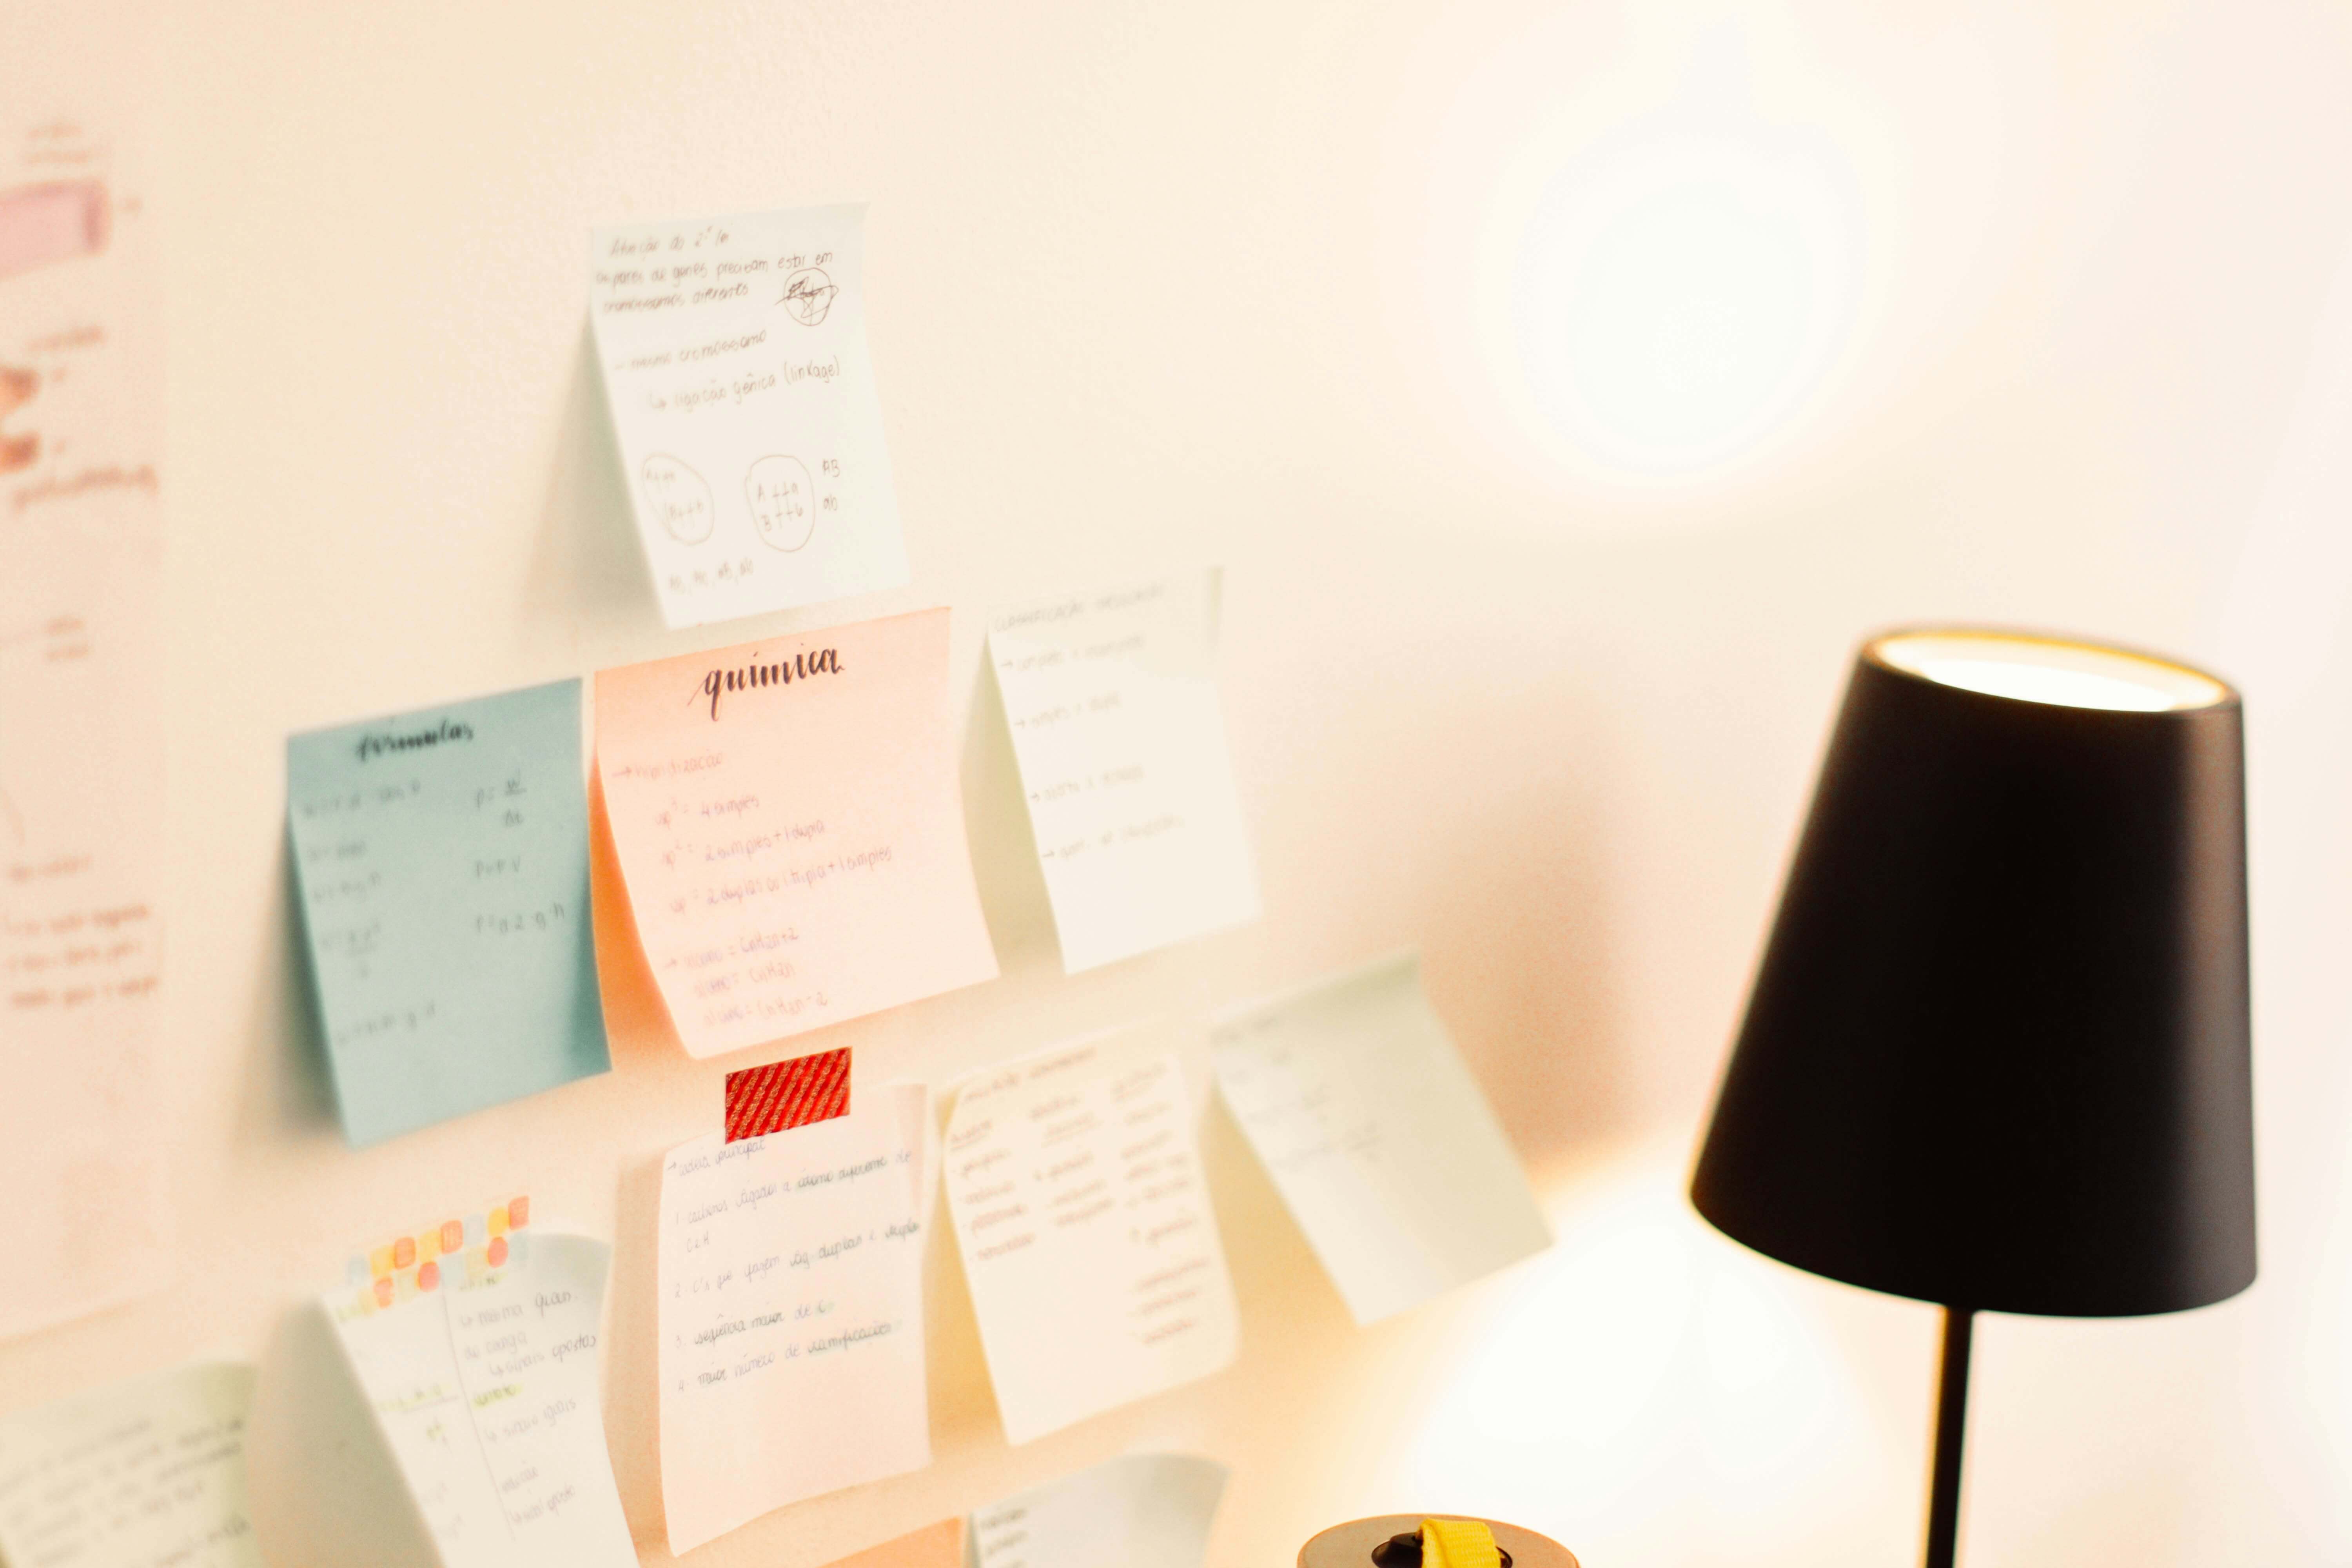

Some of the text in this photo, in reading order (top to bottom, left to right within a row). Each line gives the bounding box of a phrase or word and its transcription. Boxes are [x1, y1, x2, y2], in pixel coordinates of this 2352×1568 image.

[717, 258, 768, 279] precisam
[778, 252, 806, 269] estar
[816, 251, 833, 265] em
[693, 282, 749, 304] diferentes
[734, 372, 776, 406] gênica
[784, 354, 840, 385] (linkage)
[822, 458, 840, 477] AB
[687, 643, 846, 722] química
[744, 1255, 781, 1283] fazem
[818, 1235, 863, 1260] duplas
[795, 1303, 811, 1320] de
[734, 1352, 775, 1377] número
[785, 1342, 800, 1360] de
